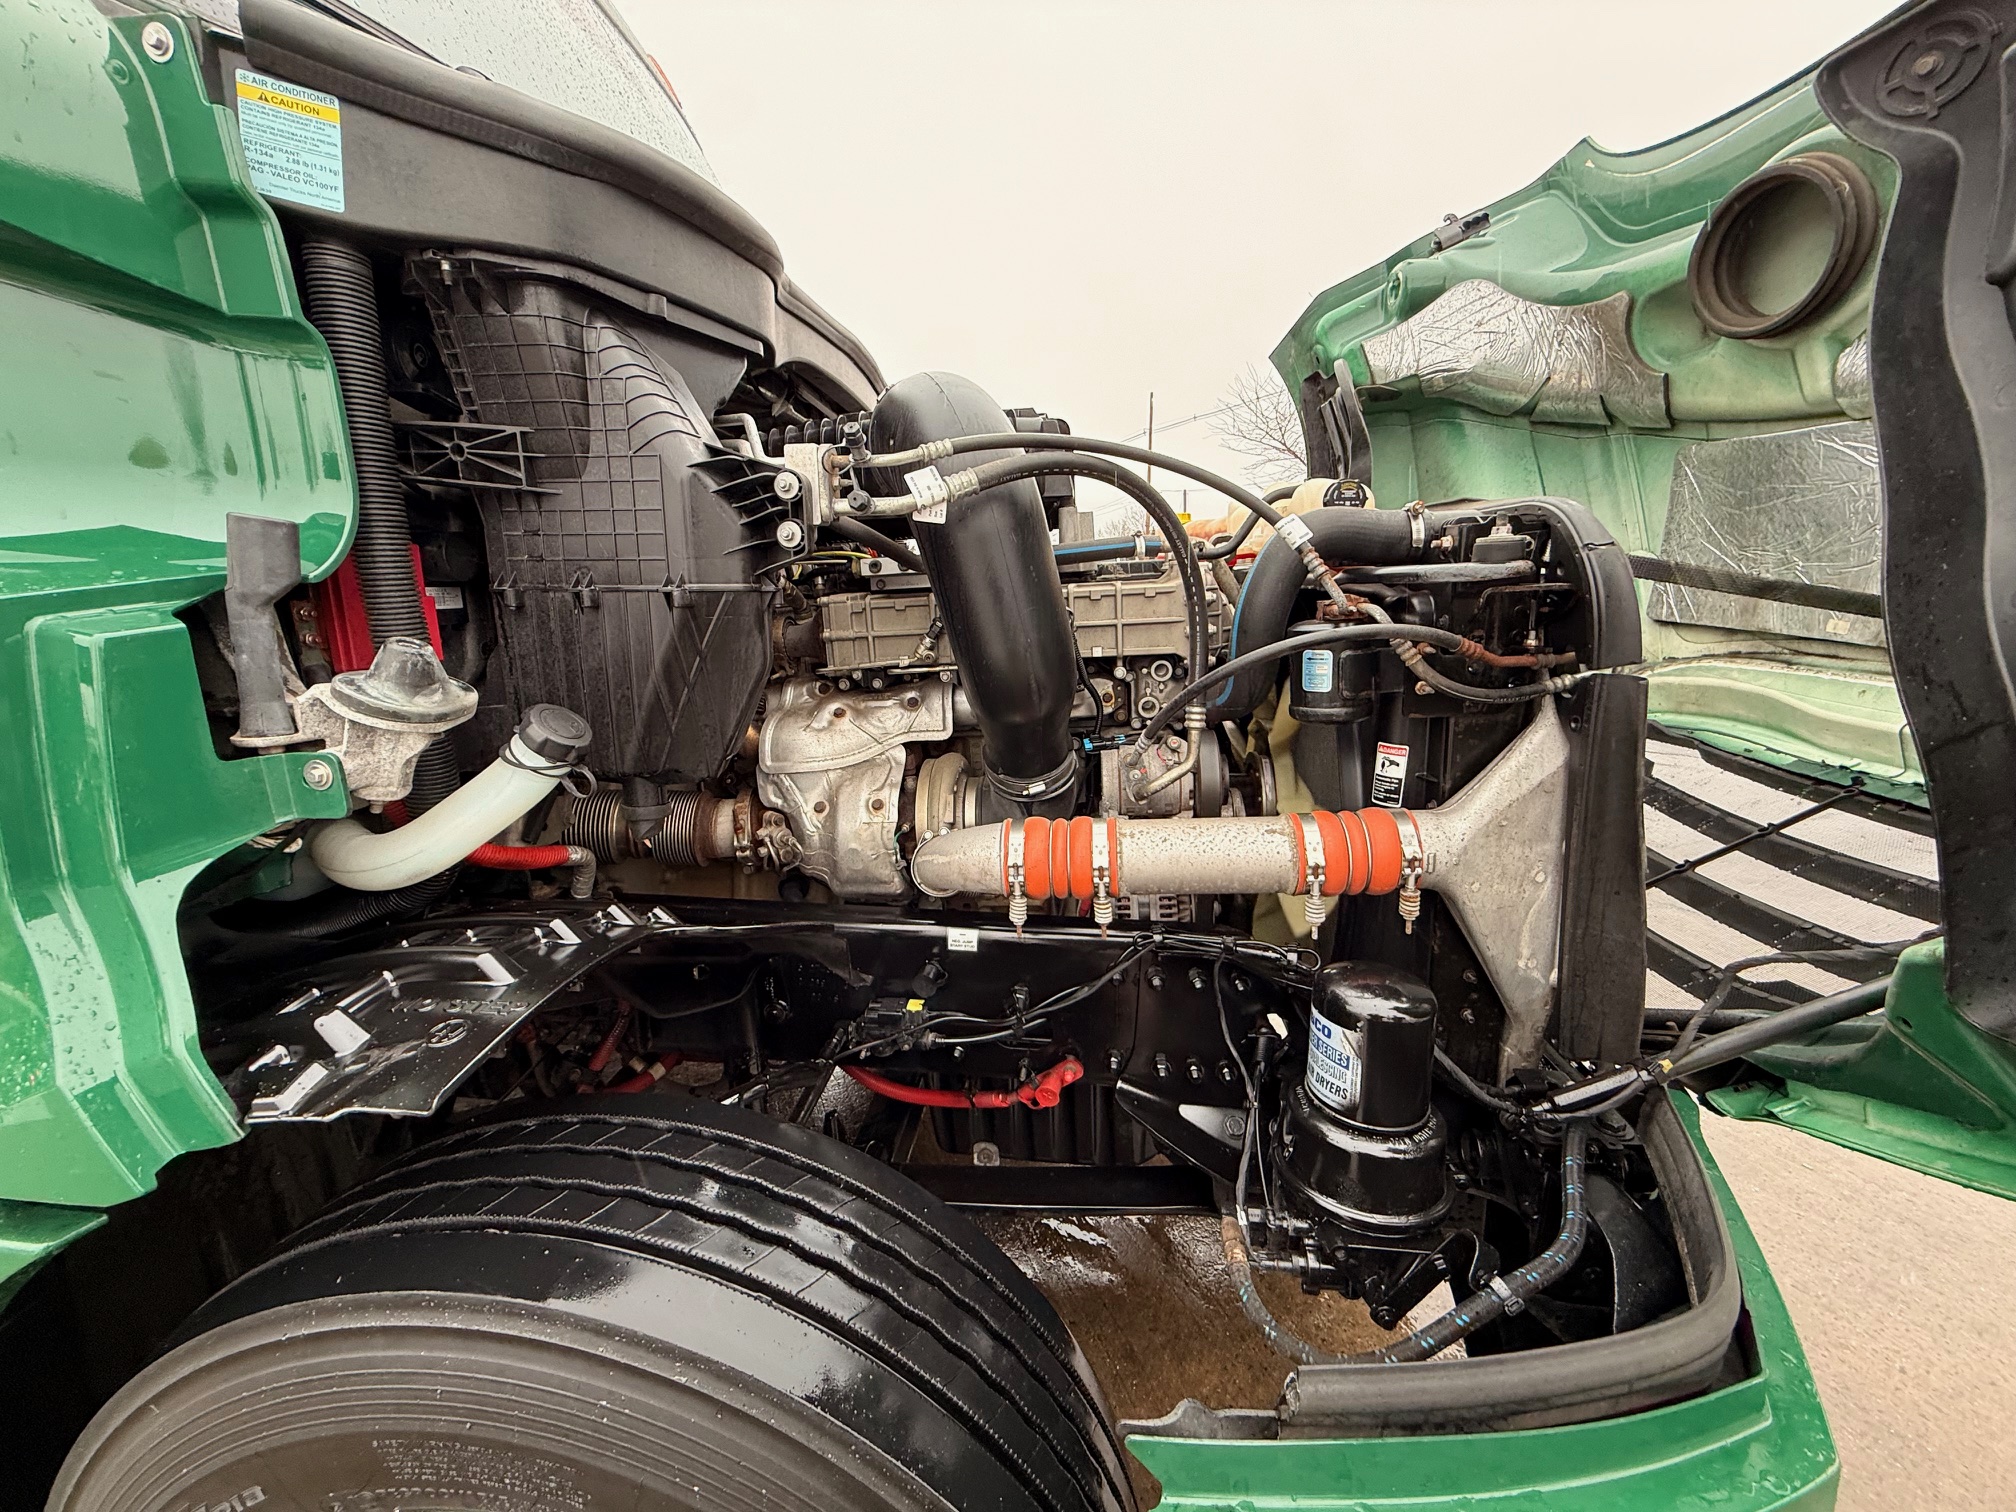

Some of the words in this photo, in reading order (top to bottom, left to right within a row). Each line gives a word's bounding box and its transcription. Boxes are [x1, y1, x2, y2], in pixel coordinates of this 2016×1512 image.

[251, 76, 268, 87] AIR
[270, 81, 335, 106] CONDITIONER
[240, 99, 266, 110] CAUTION
[267, 106, 282, 114] HIGH
[283, 110, 313, 122] PRESSURE
[240, 104, 270, 116] CONTAINS
[271, 113, 311, 127] REFRIGERANT
[270, 95, 319, 116] CAUTION
[242, 123, 267, 134] CONTIENE
[268, 130, 306, 144] REFRIGERANTE
[276, 127, 298, 137] SISTEMA
[243, 137, 301, 158] REFRIGERANT:
[243, 145, 273, 158] R-134a
[285, 156, 300, 165] 2.88
[310, 162, 326, 173] (1.31
[328, 167, 339, 176] kg)
[245, 156, 300, 176] COMPRESSOR
[302, 170, 317, 180] OIL:
[270, 169, 300, 183] VALEO
[302, 177, 339, 192] VC100YF
[442, 999, 530, 1015] STEP
[1318, 1039, 1347, 1067] SERIES
[1315, 1071, 1348, 1100] DRYERS
